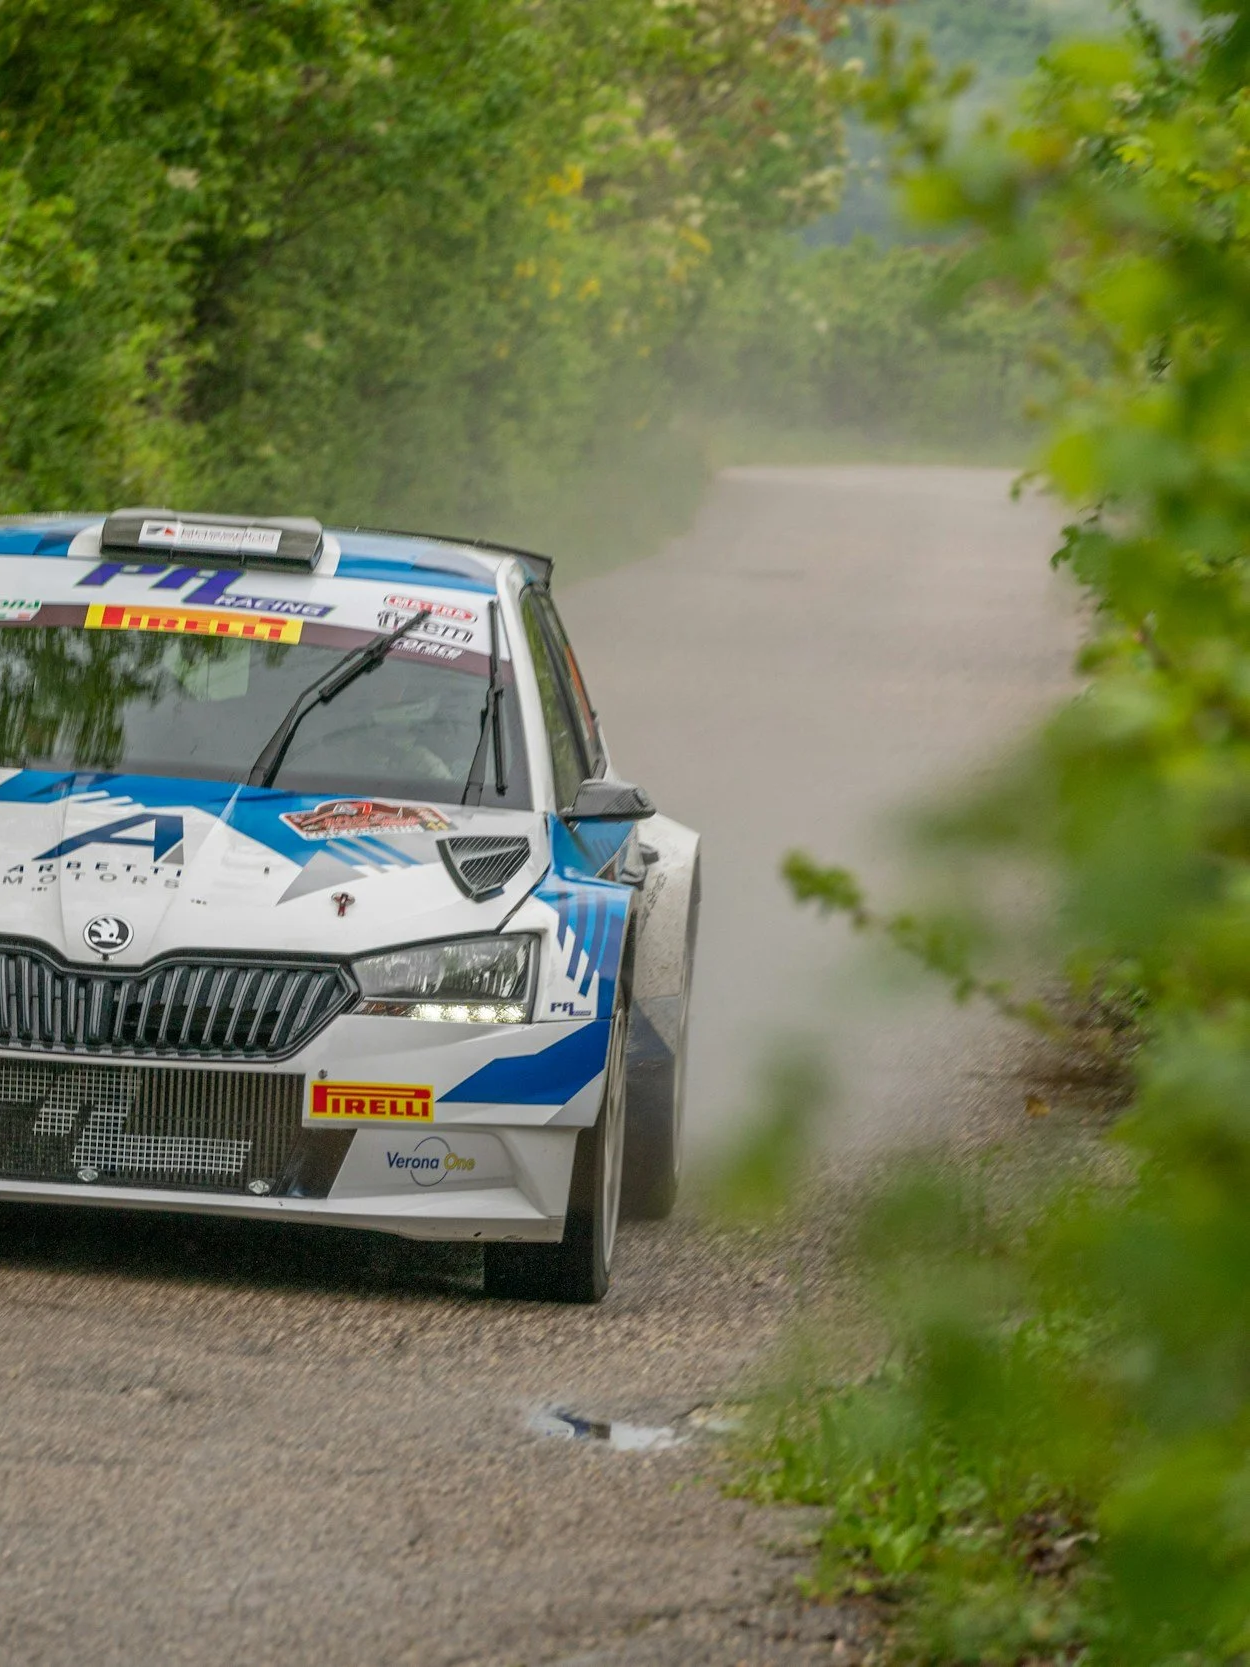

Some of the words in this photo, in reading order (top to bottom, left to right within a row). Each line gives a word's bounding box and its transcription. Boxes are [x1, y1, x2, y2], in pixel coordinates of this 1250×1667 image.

[213, 594, 325, 617] RACING
[100, 605, 288, 640] PIRELLI
[7, 861, 183, 878] ARBETTI
[1, 872, 181, 890] MOTORS
[312, 1084, 432, 1117] PIRELLI
[386, 1151, 439, 1170] Verona
[443, 1152, 476, 1171] One
